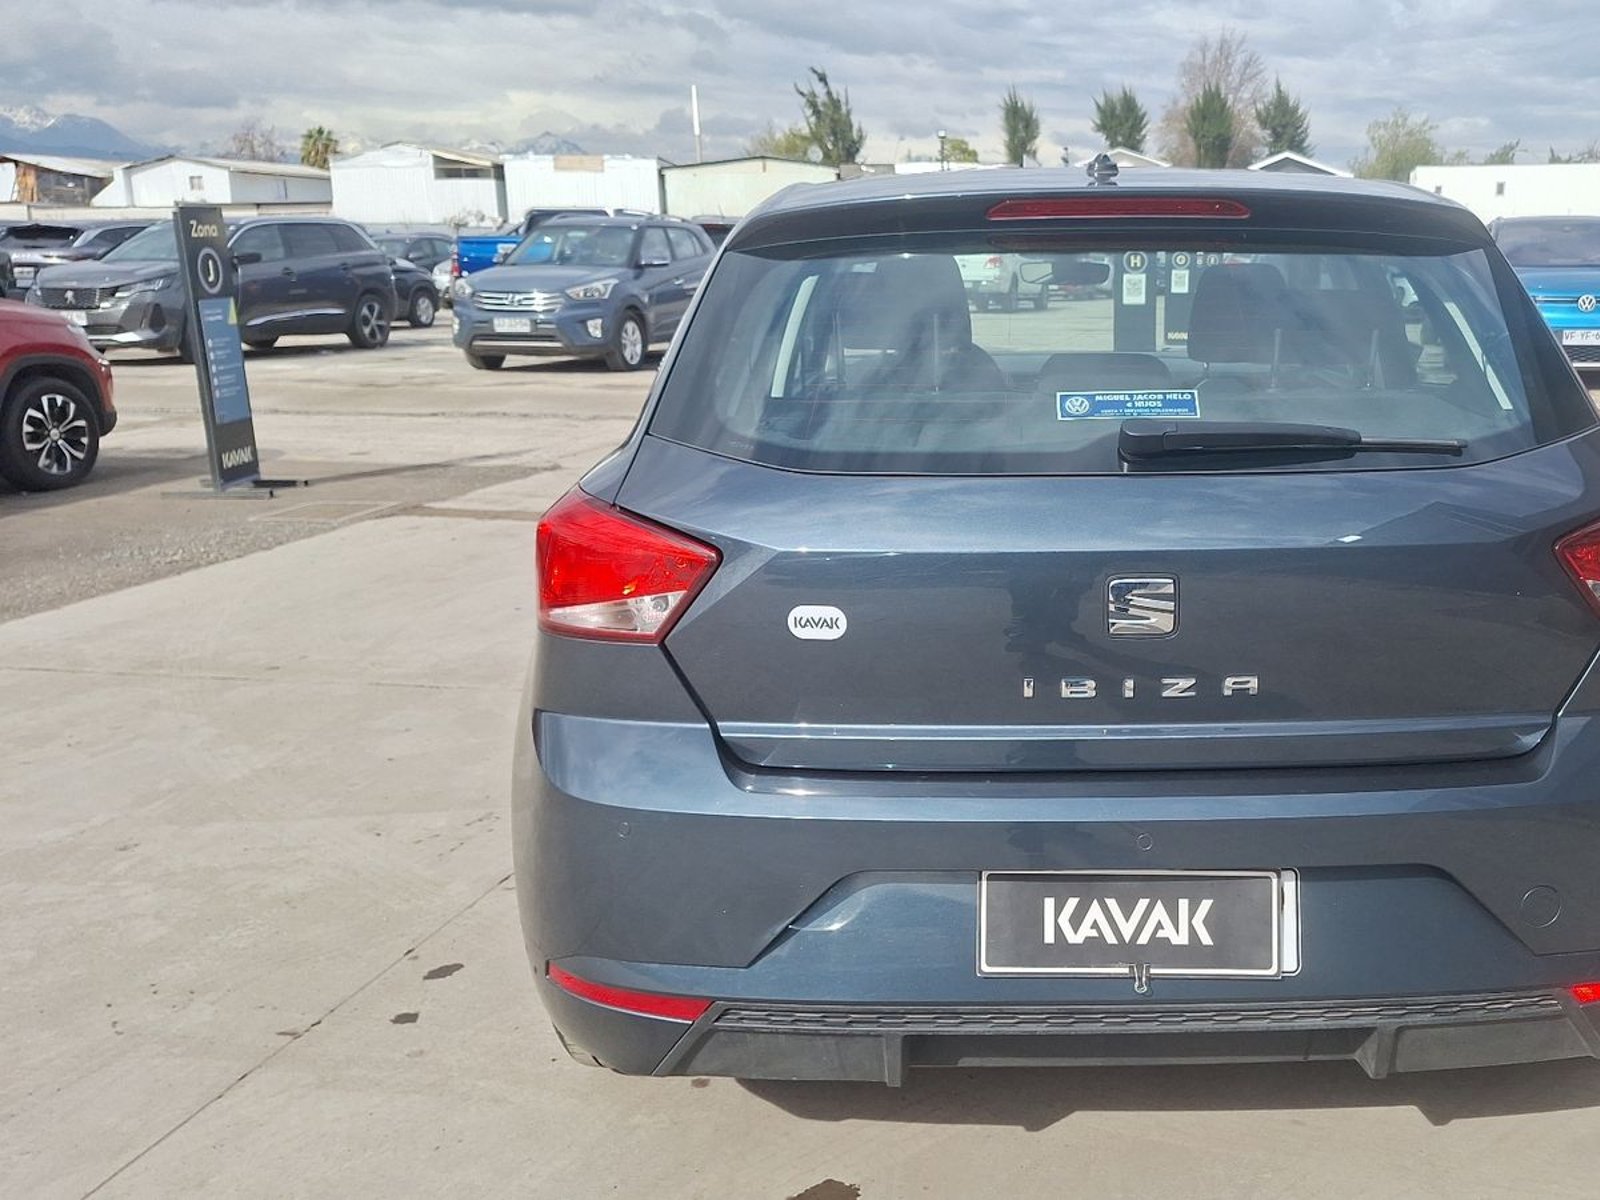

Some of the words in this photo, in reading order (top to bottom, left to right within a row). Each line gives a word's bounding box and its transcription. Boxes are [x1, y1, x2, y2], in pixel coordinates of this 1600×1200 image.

[190, 220, 218, 237] Zona
[208, 259, 215, 282] J
[1130, 254, 1141, 267] H
[221, 445, 254, 470] KAVAK
[793, 616, 841, 632] KAVAK
[1022, 675, 1259, 699] IBIZA
[1043, 896, 1214, 946] KAVAK
